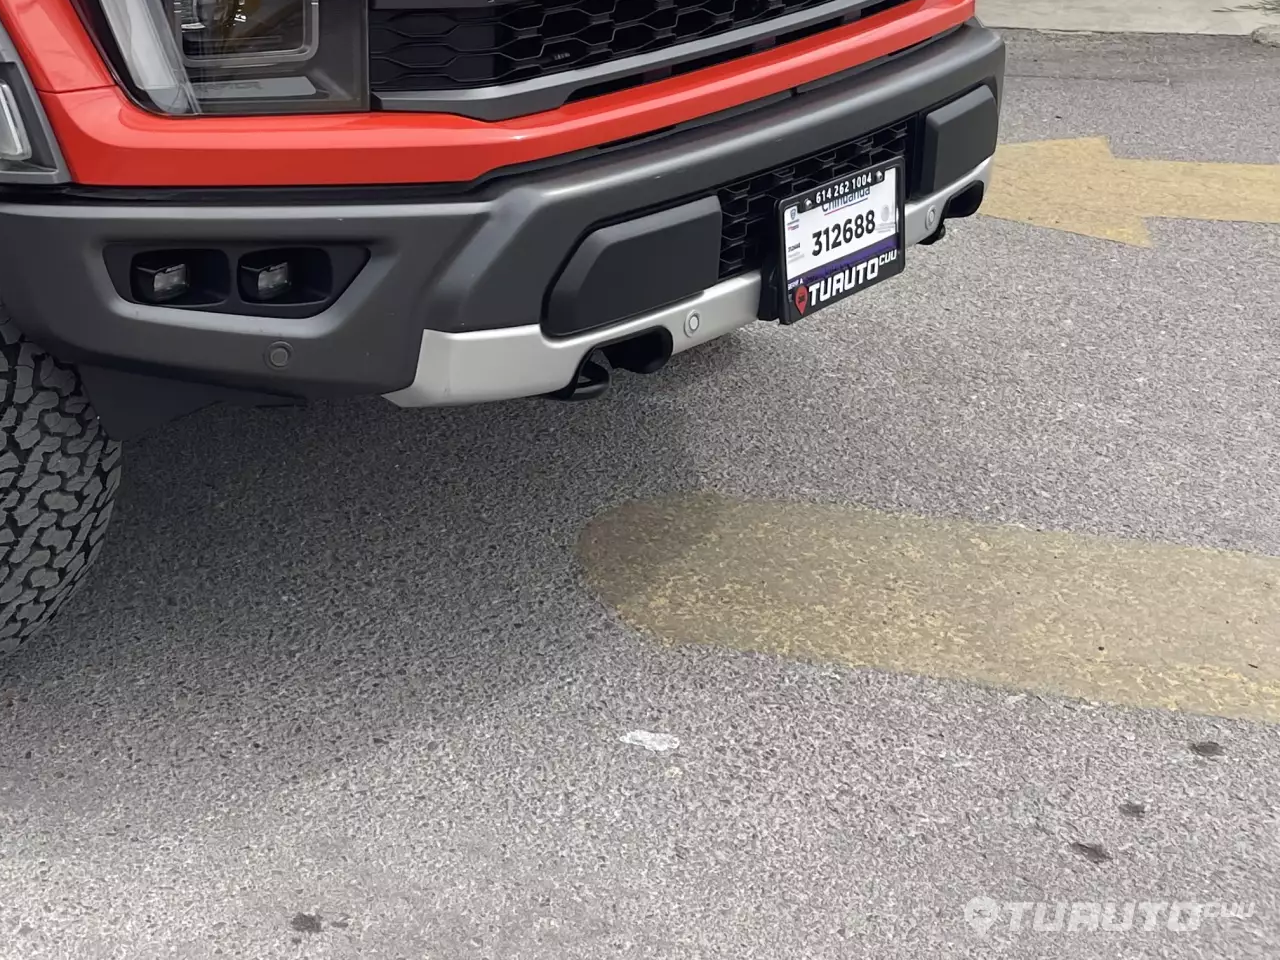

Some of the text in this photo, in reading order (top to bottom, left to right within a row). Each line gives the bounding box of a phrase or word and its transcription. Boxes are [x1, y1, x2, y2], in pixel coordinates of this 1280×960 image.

[815, 172, 872, 204] 614 262 1004
[812, 210, 875, 256] 312688
